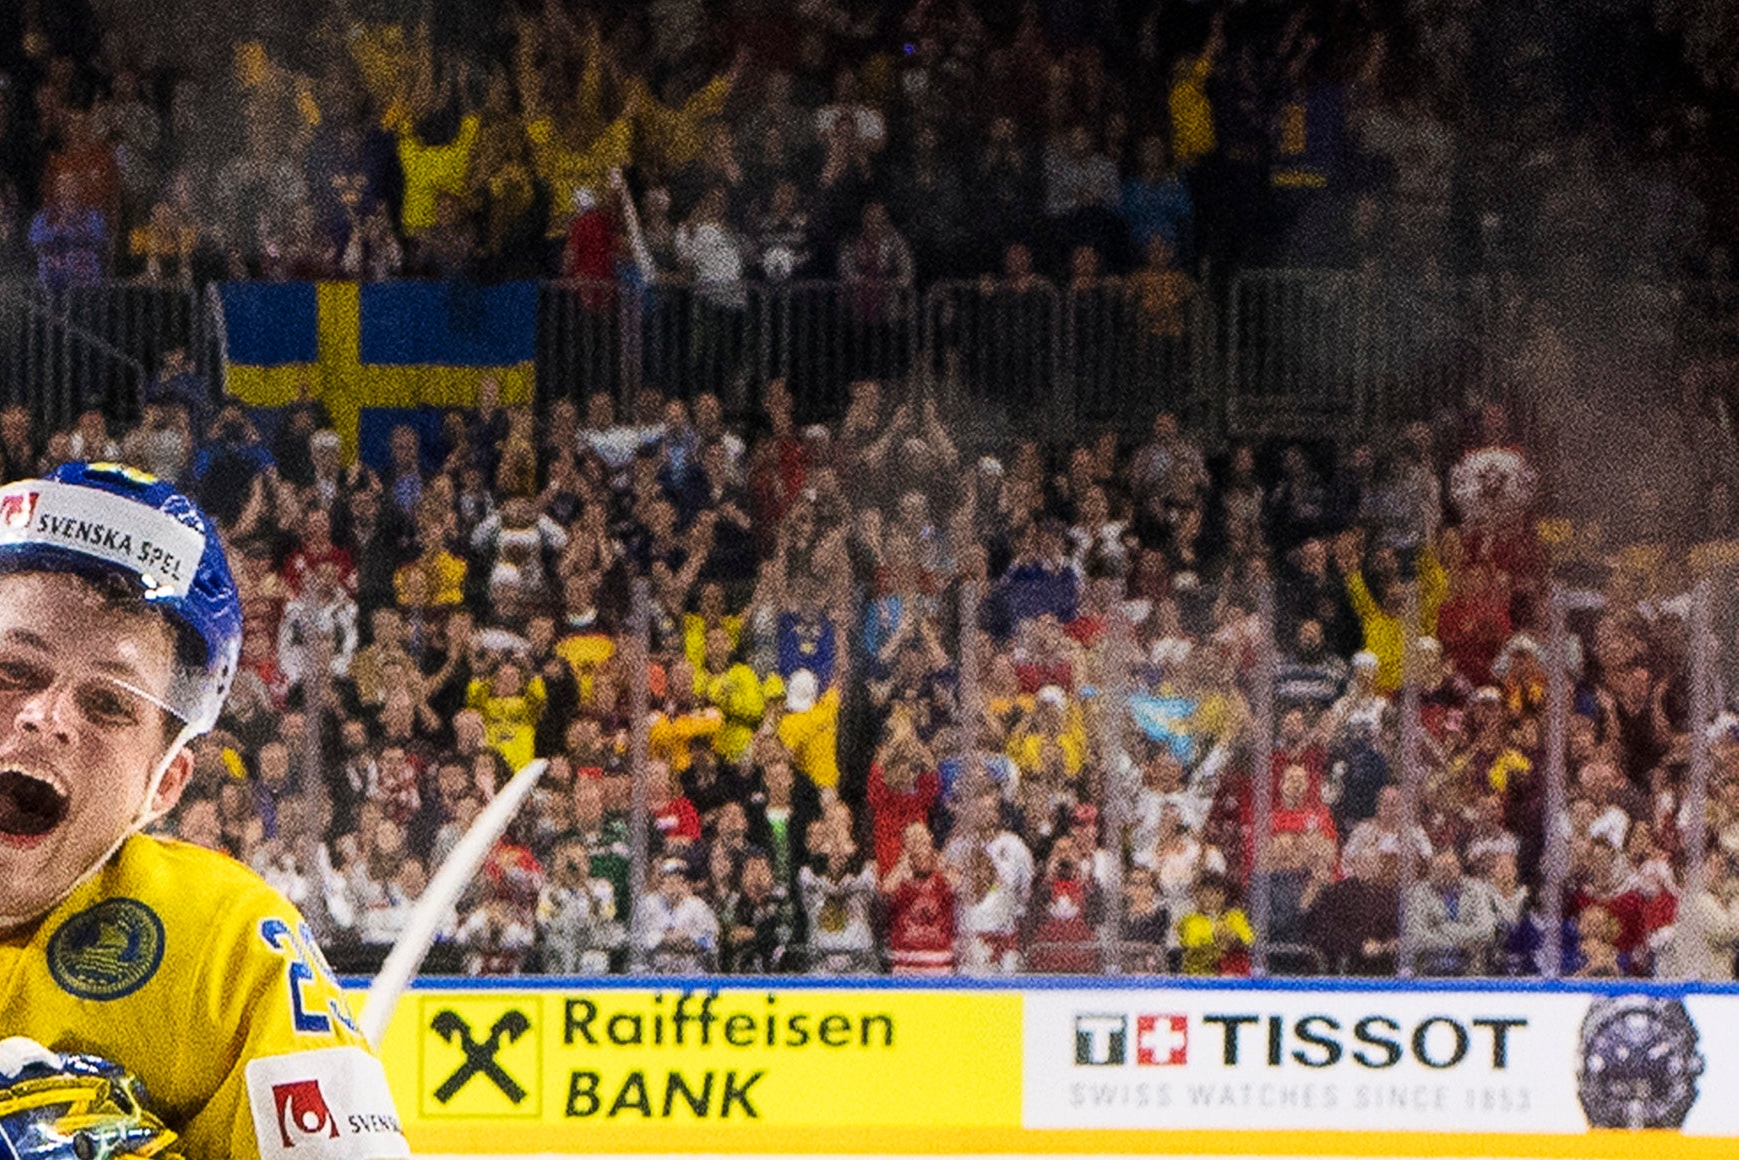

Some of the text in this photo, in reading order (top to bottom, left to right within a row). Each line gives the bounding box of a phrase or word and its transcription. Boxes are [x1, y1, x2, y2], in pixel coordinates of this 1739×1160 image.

[37, 513, 182, 581] SVENSKA SPEL
[563, 988, 894, 1046] Raiffeisen
[1203, 1014, 1529, 1069] TISSOT
[565, 1071, 767, 1118] BANK
[1069, 1082, 1171, 1107] SWISS
[1188, 1082, 1337, 1110] WATCHES
[1354, 1084, 1449, 1111] SINCE
